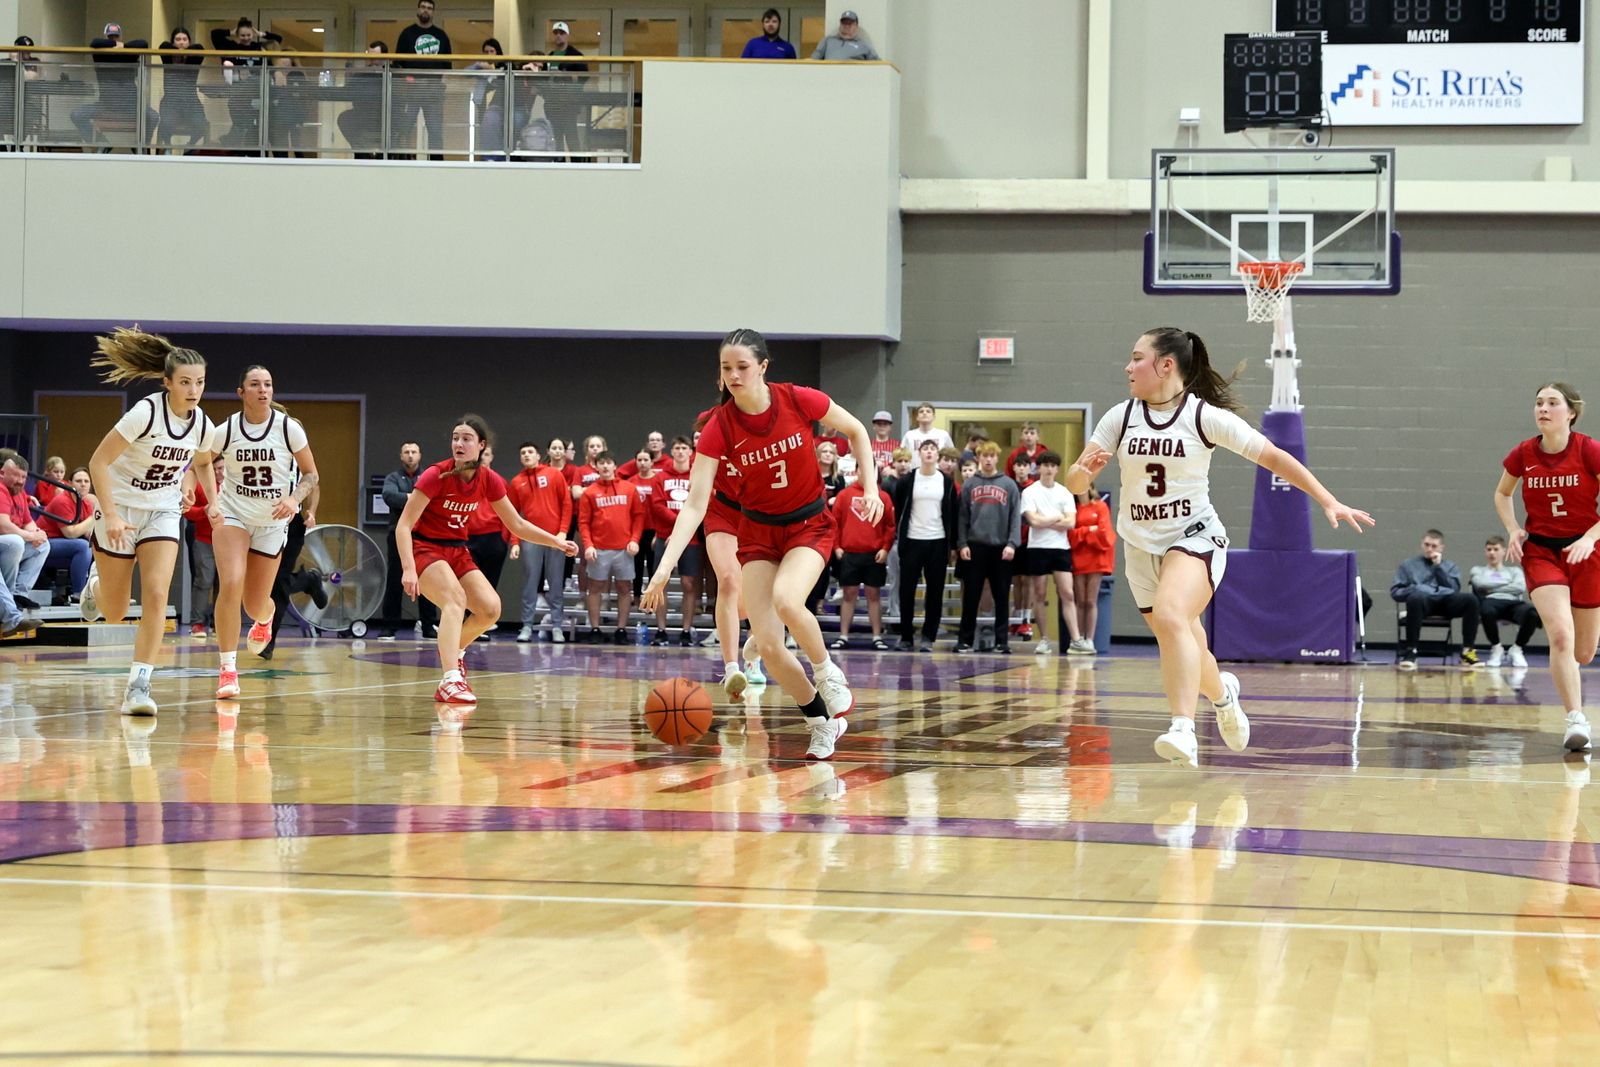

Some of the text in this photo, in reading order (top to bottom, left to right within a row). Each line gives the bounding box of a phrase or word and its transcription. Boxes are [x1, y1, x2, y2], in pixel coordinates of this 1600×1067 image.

[1407, 29, 1449, 42] MATCH
[1527, 28, 1567, 41] SCORE
[1392, 98, 1522, 108] HEALTH PARTNERS
[986, 339, 1009, 357] EXIT
[152, 445, 190, 461] GENOA
[236, 448, 276, 462] GENOA
[740, 432, 803, 466] BELLEVUE
[1128, 438, 1186, 457] GENOA
[242, 466, 273, 487] 23
[537, 476, 548, 488] B
[768, 460, 788, 489] 3
[1145, 463, 1166, 498] 3
[1528, 474, 1579, 488] BELLEVUE
[1130, 499, 1191, 521] COMETS
[1547, 493, 1568, 517] 2
